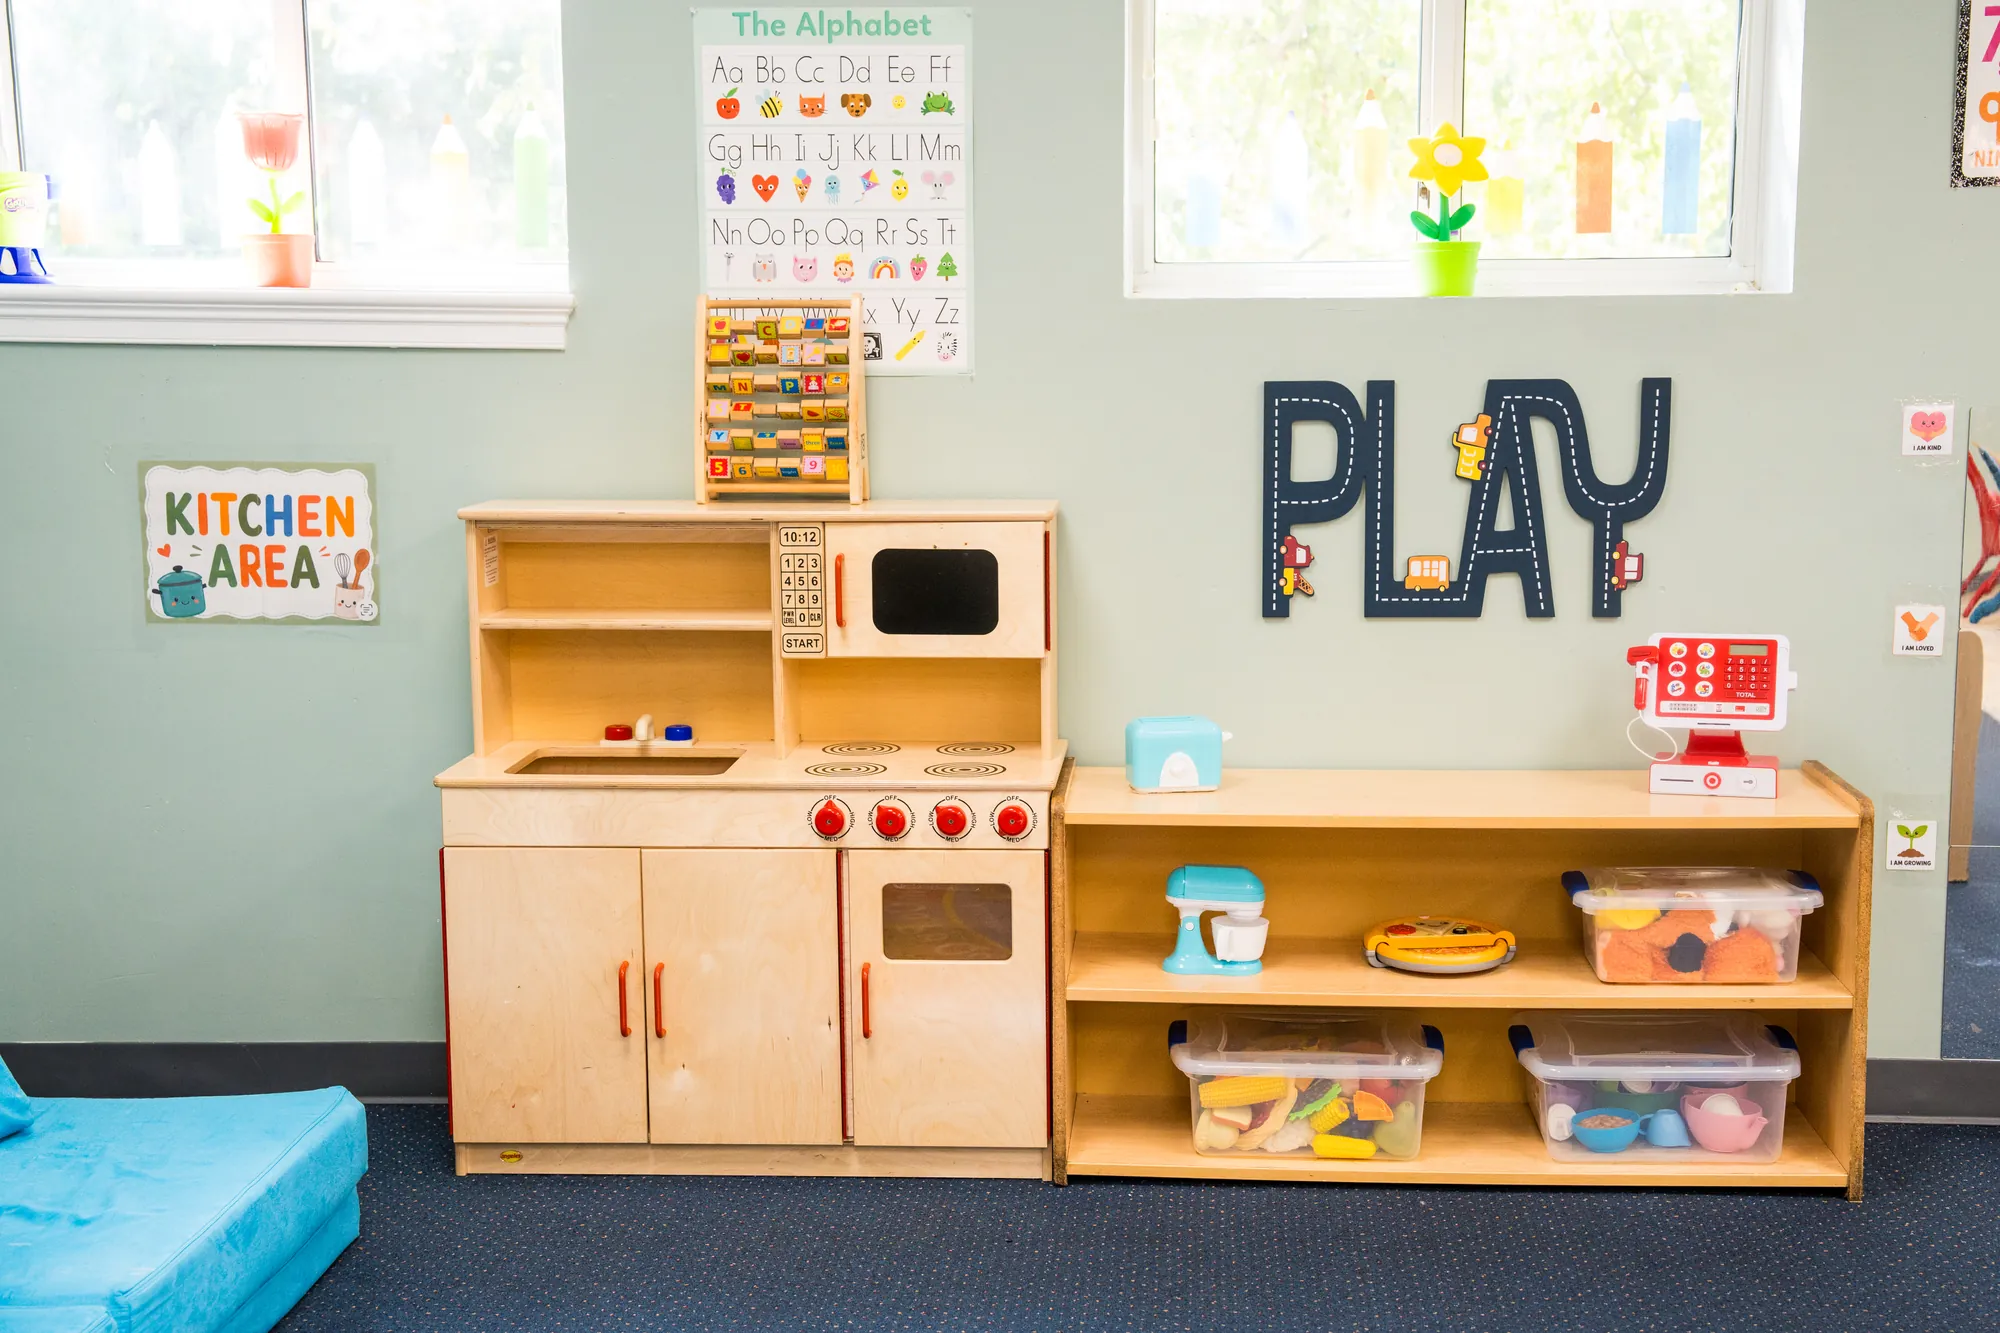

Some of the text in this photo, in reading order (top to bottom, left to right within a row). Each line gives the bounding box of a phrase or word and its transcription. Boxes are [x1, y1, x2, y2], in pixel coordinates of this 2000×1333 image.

[732, 10, 932, 44] The Alphabet
[712, 56, 951, 83] Aa Bb Cc Dd Ee Ff
[708, 134, 960, 170] Gg Hh Ii Jj Kk Ll Mm
[713, 218, 956, 252] Nn Oo Pp Qq Rr Ss Tt
[892, 298, 920, 332] Yy
[935, 298, 959, 324] Zz
[786, 320, 796, 330] D
[763, 326, 772, 336] C
[738, 382, 748, 391] N
[785, 381, 794, 391] P
[716, 404, 722, 414] S
[715, 462, 723, 472] 5
[809, 460, 818, 470] 9
[832, 464, 844, 474] 10
[738, 467, 747, 475] 6
[1262, 377, 1672, 618] PLAY
[166, 492, 354, 537] KITCHEN
[784, 532, 816, 542] 10:12
[208, 544, 320, 588] AREA
[784, 558, 818, 568] 1 2 3
[784, 576, 818, 586] 4 5 6
[786, 594, 818, 604] 7 8 9
[799, 612, 806, 622] 0
[810, 613, 821, 621] CLR
[786, 639, 820, 648] START
